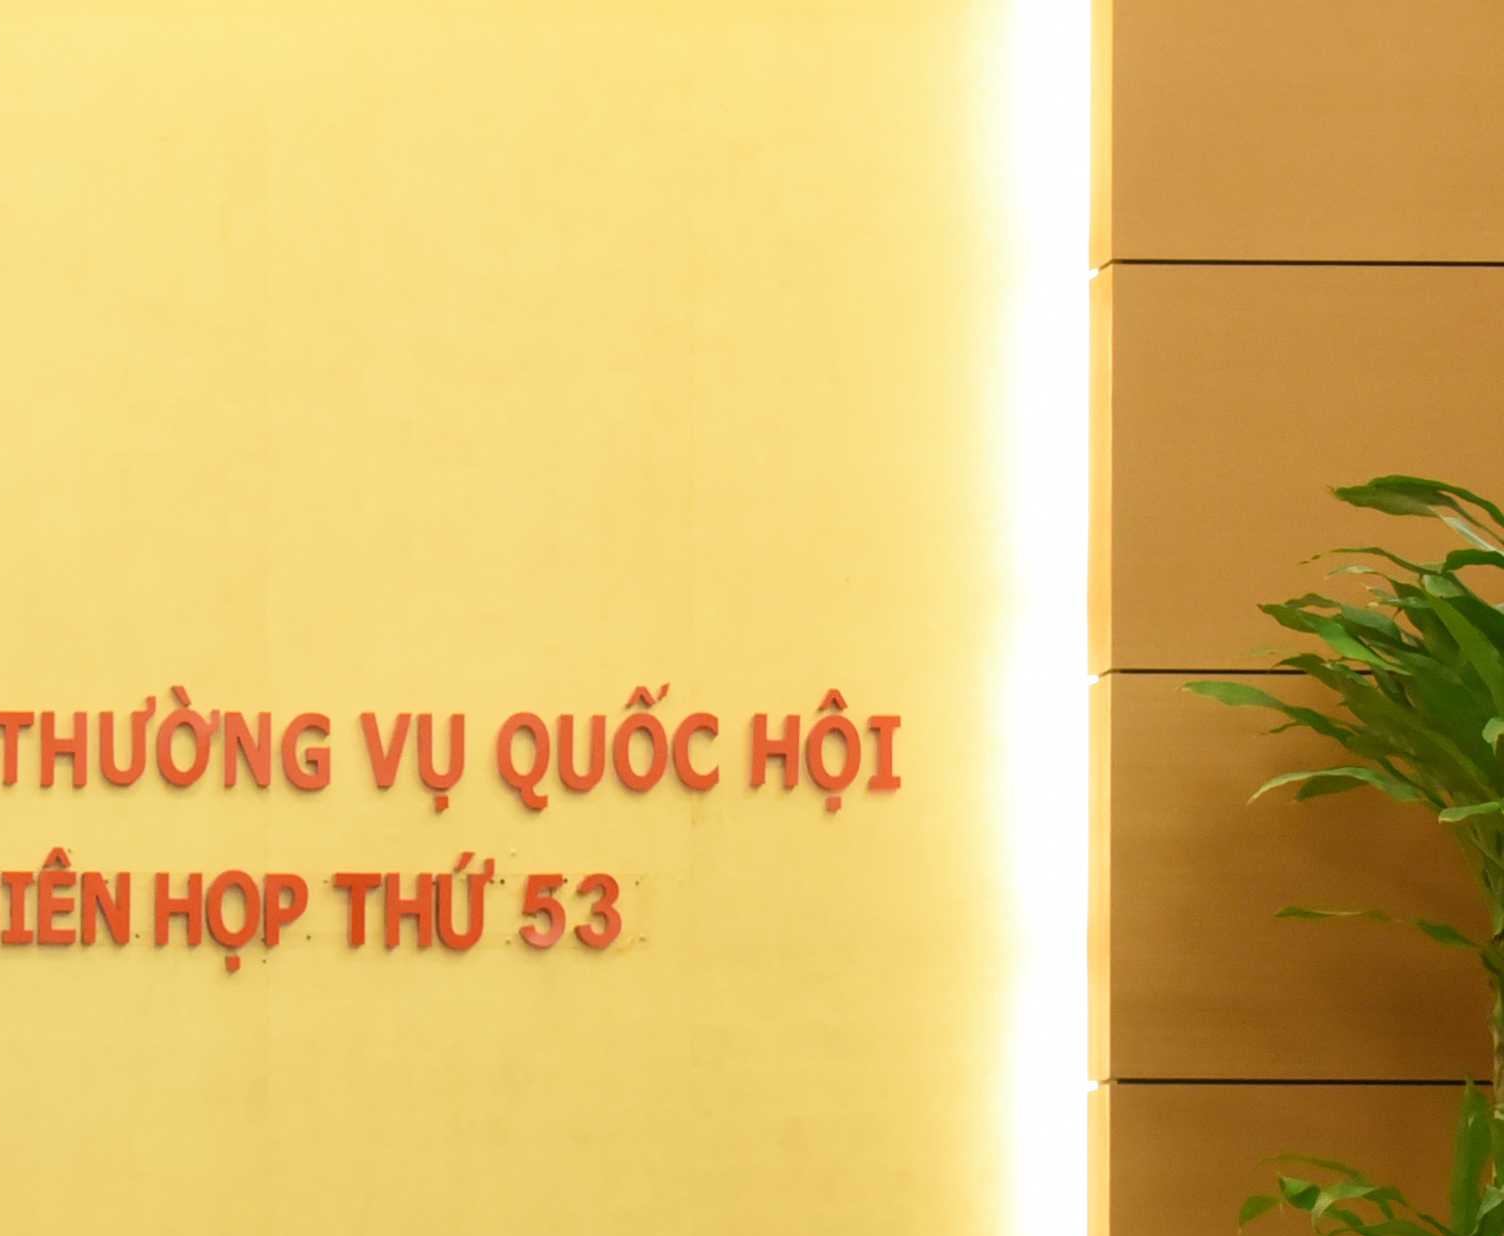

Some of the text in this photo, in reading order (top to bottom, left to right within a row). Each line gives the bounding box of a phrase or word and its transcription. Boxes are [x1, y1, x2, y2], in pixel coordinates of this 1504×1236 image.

[362, 712, 465, 810] VỤ
[496, 684, 720, 810] QUỐC
[751, 690, 902, 811] HỘI
[155, 869, 309, 971] HỌP
[334, 852, 495, 950] THỨ
[522, 873, 623, 948] 53
